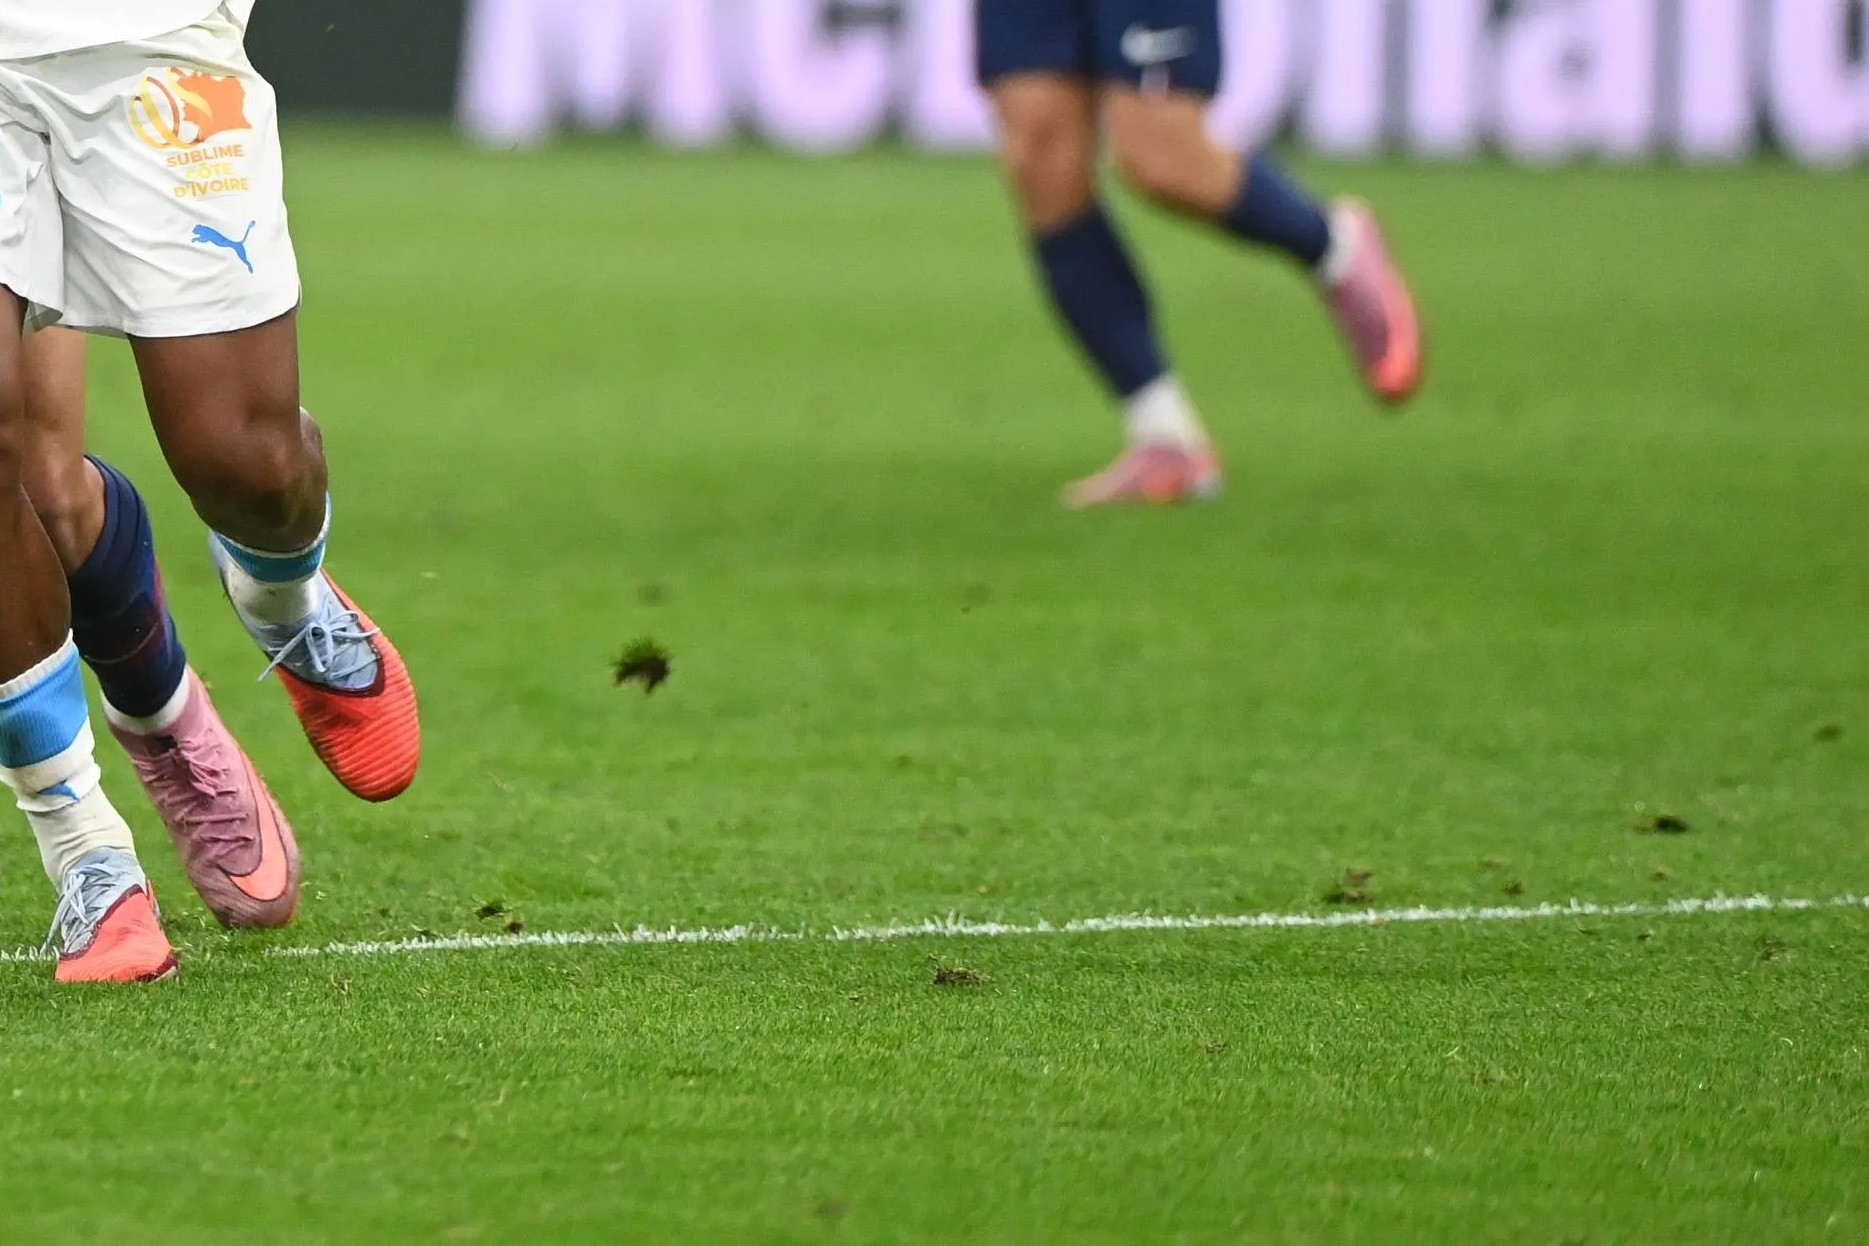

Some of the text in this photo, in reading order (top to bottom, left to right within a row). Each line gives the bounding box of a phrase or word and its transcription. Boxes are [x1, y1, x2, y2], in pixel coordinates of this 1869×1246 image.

[166, 144, 245, 167] SUBLIME
[185, 162, 234, 180] CÔTE
[174, 178, 249, 198] D'IVOIRE
